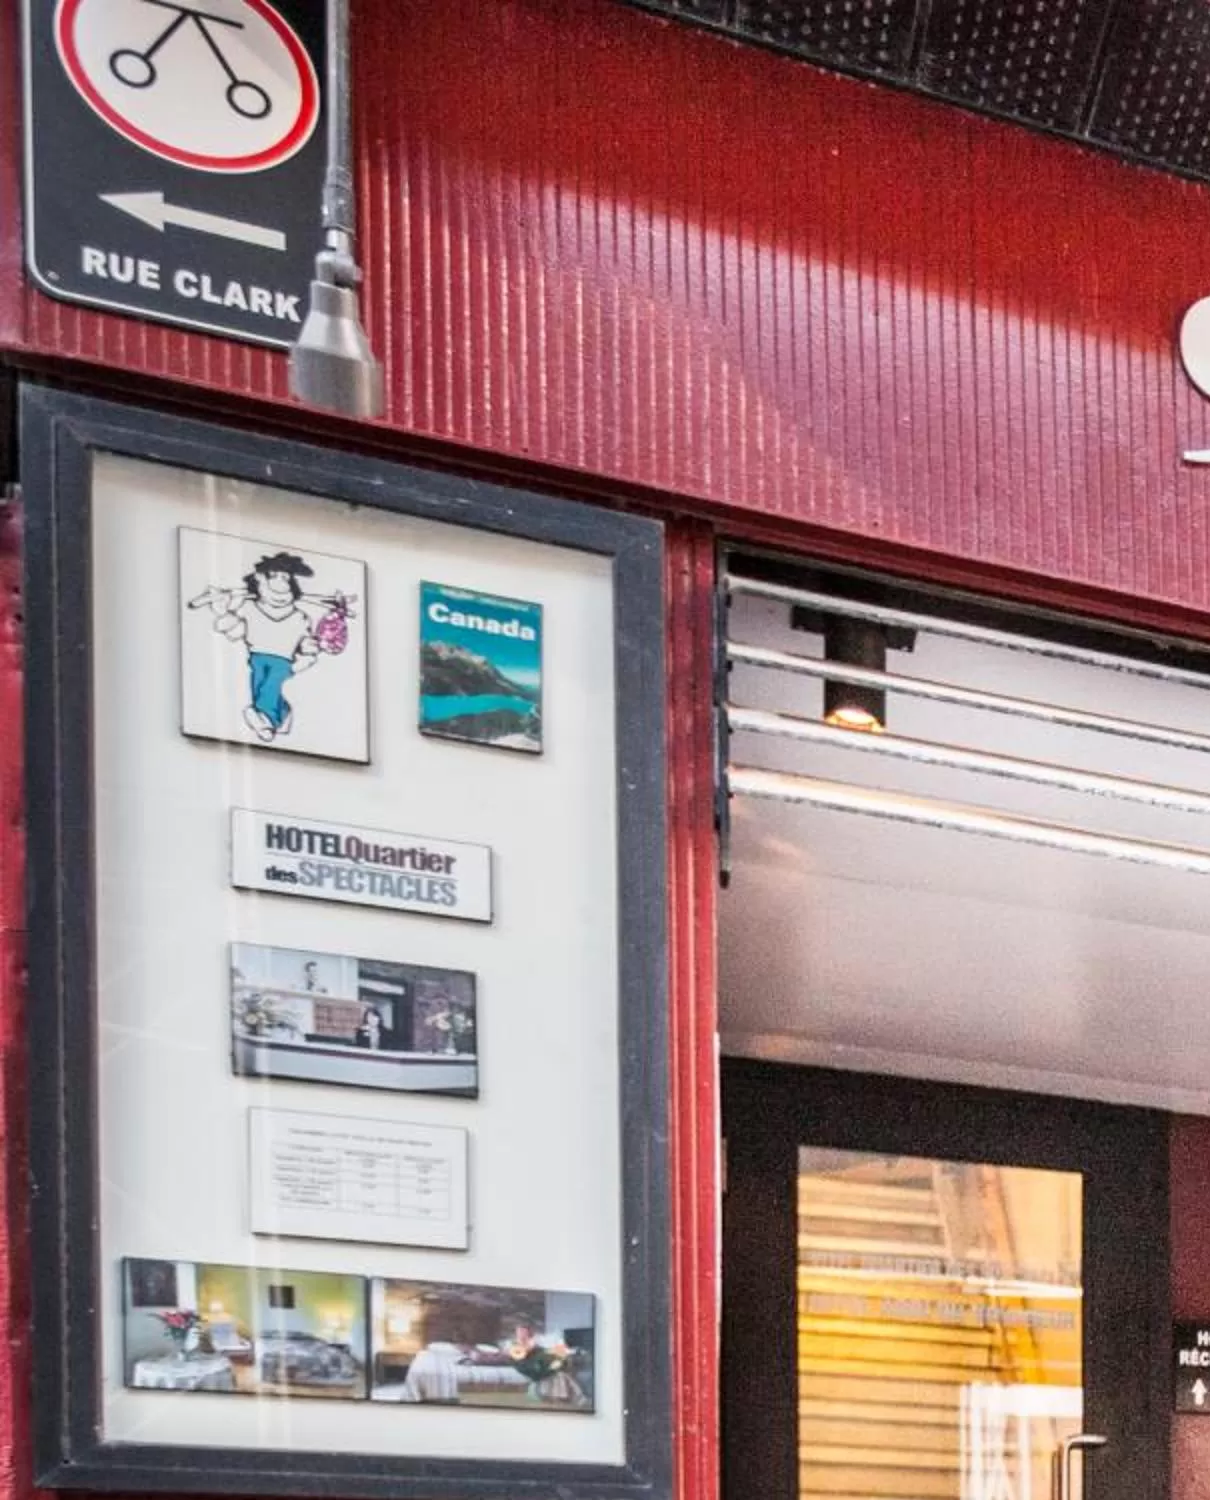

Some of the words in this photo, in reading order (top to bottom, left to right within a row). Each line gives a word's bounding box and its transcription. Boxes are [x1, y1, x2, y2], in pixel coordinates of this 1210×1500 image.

[81, 245, 161, 291] RUE
[173, 268, 302, 323] CLARK
[428, 603, 536, 641] Canada
